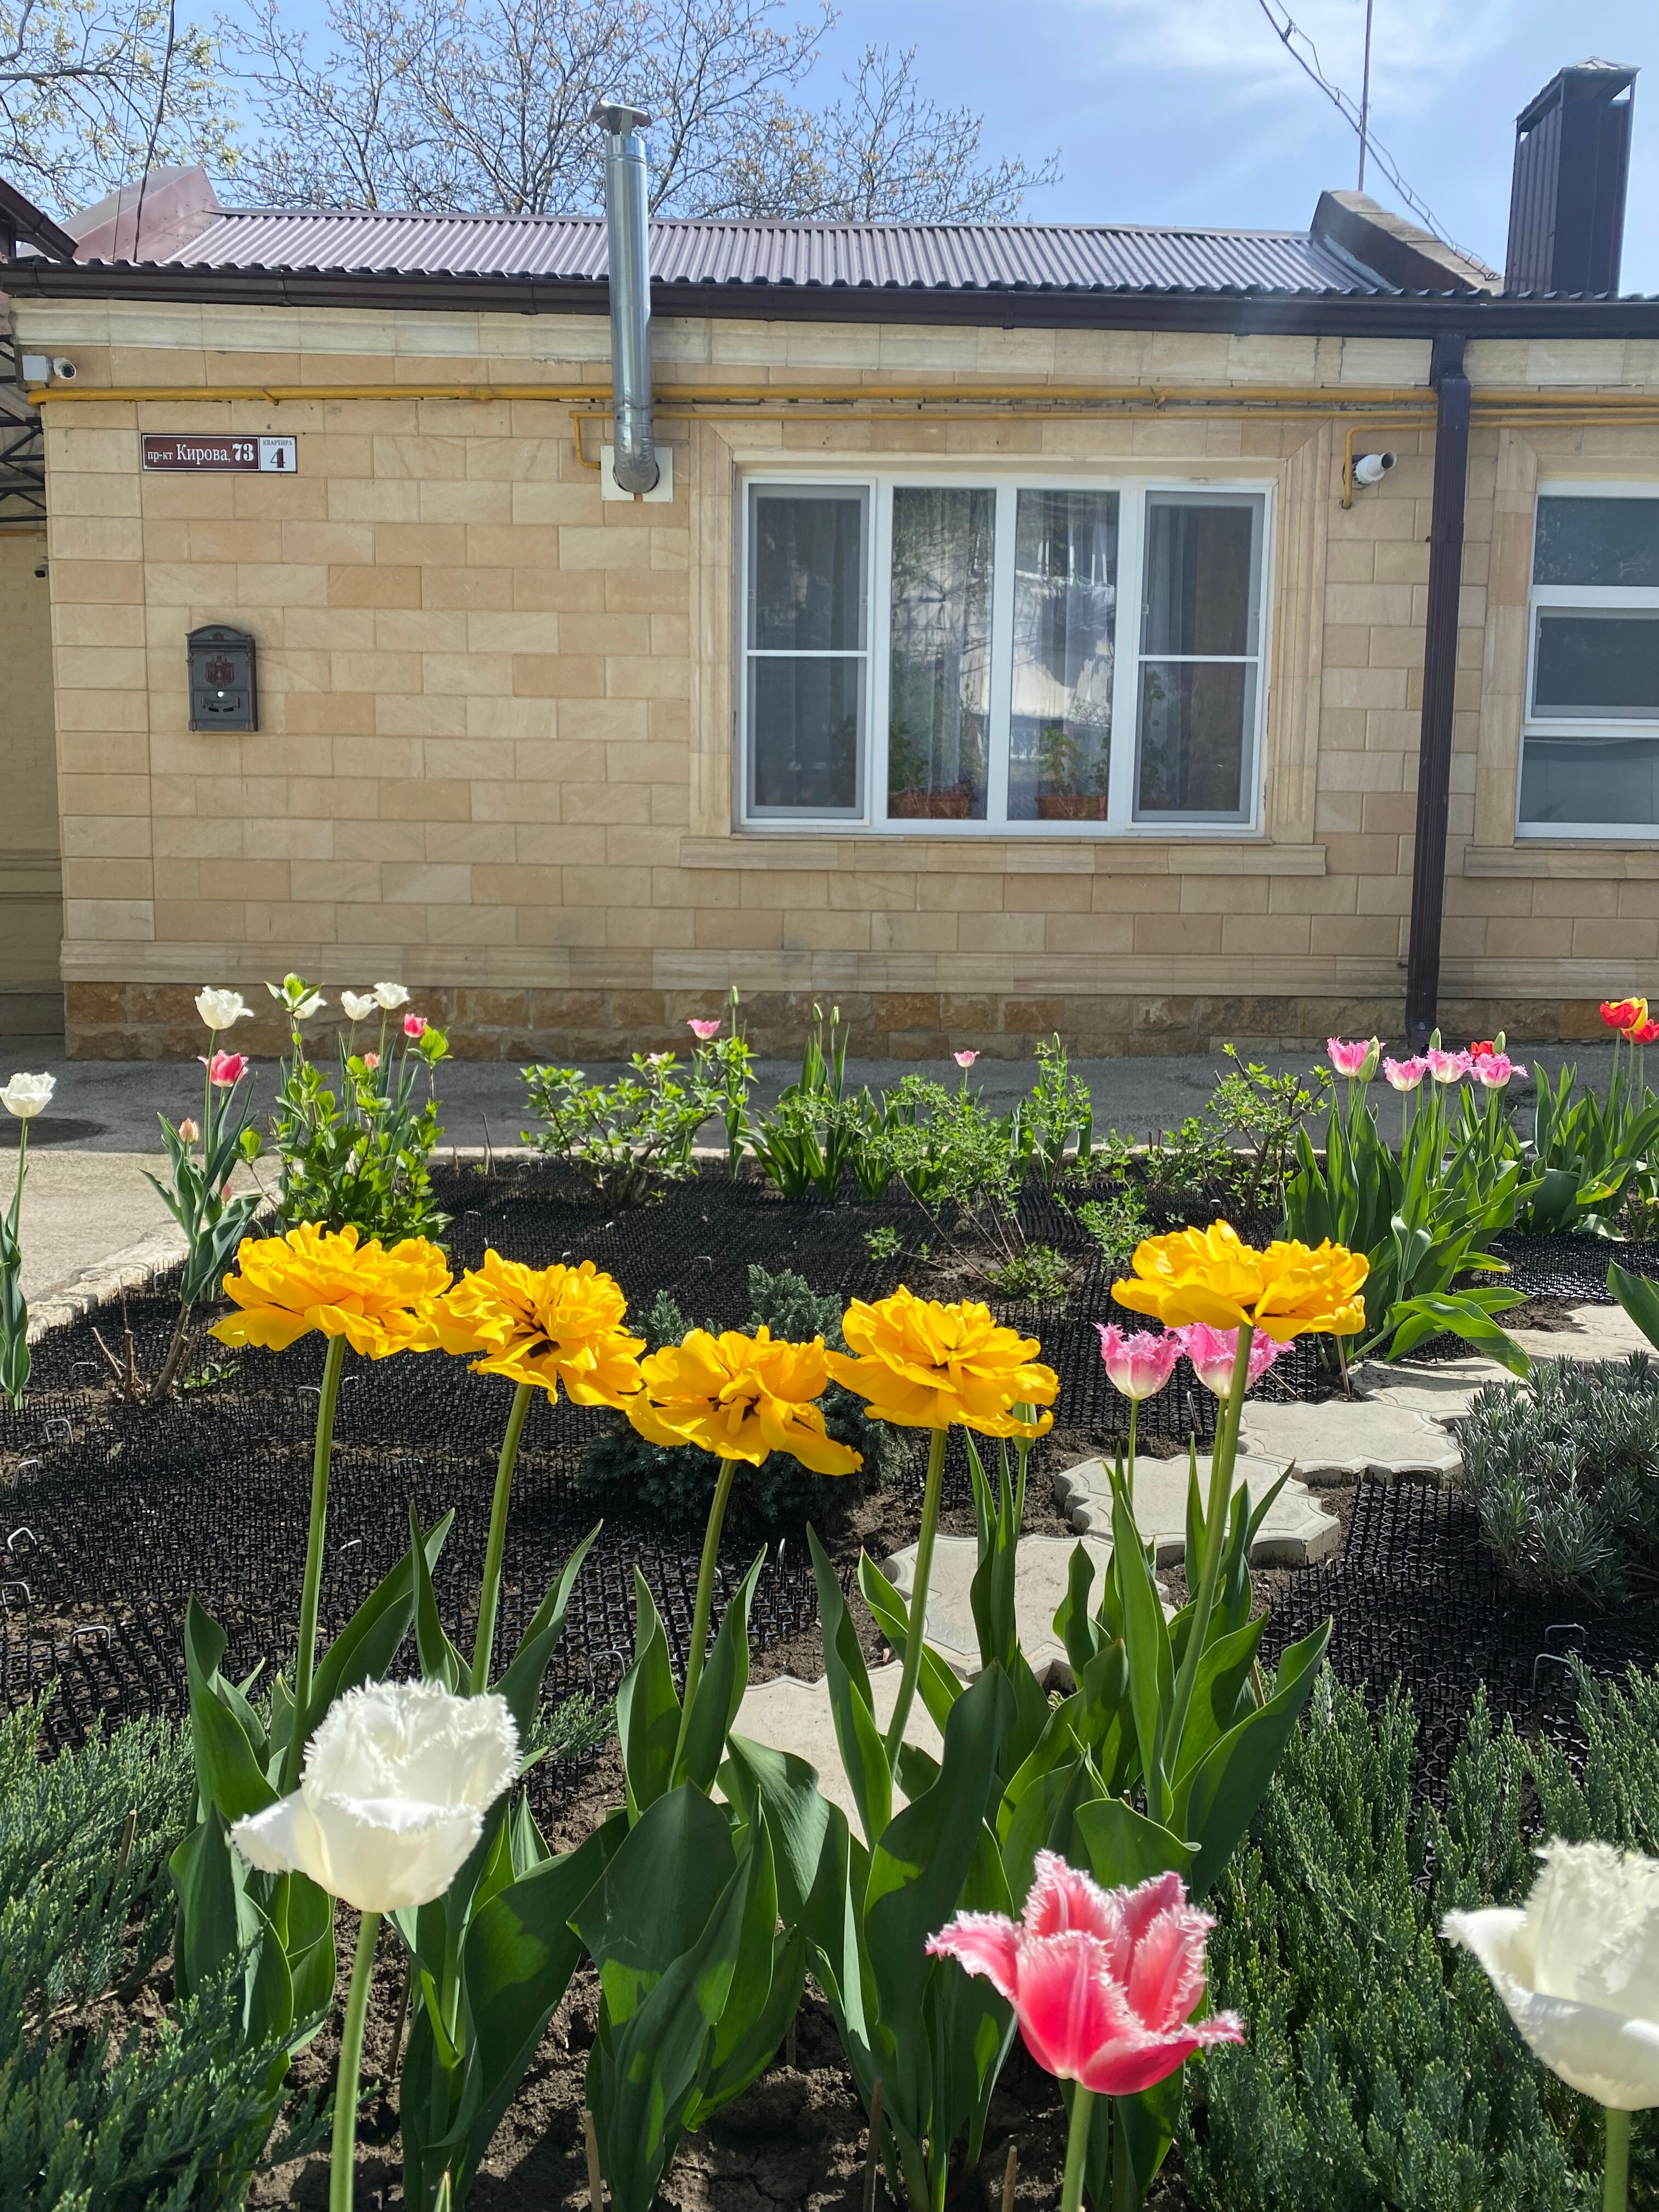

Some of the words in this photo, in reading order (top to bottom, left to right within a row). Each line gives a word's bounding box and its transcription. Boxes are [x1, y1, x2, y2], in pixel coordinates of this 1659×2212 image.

[147, 451, 173, 462] пр-кт
[176, 444, 230, 465] Кирова,
[232, 443, 253, 461] 73
[269, 448, 286, 469] 4
